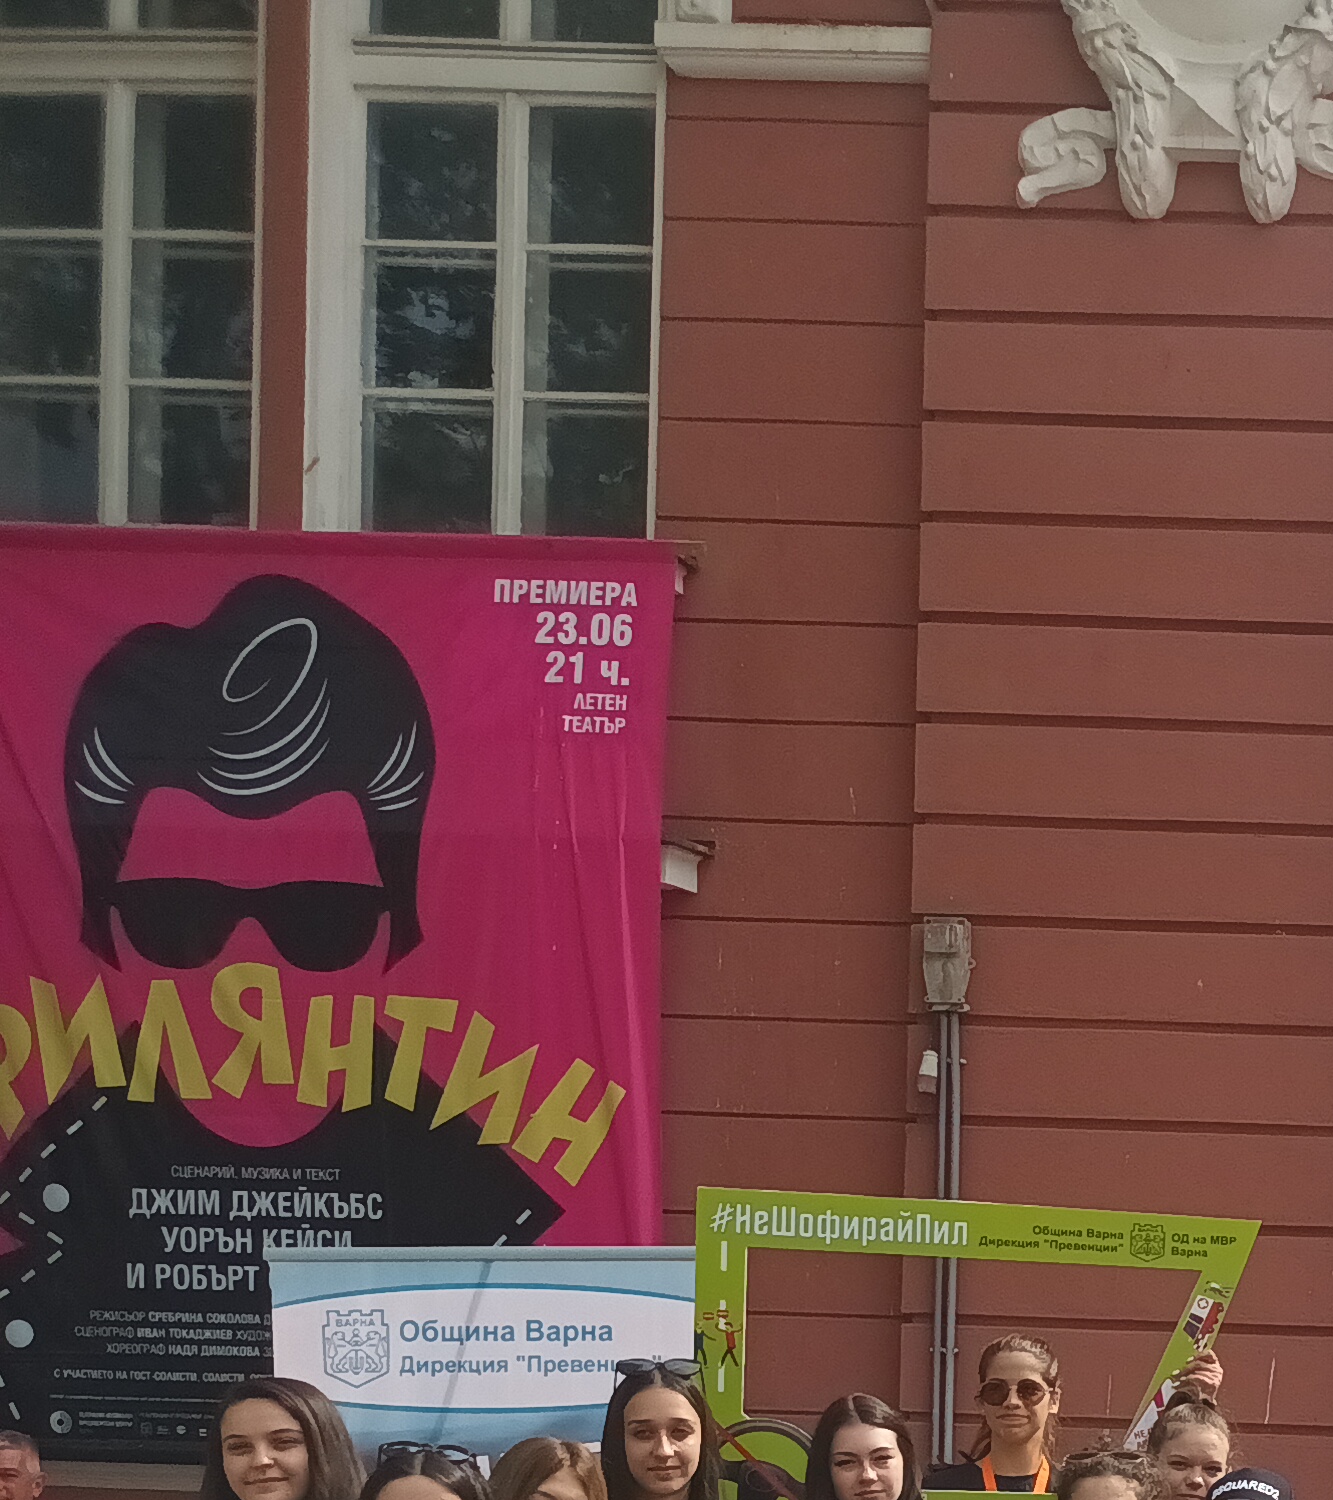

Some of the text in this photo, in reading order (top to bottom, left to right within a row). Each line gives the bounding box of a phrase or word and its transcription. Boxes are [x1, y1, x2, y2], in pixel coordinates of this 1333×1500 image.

[494, 578, 638, 607] ПРЕМИЕРА
[534, 611, 633, 647] 23.06
[544, 650, 630, 686] 21 ч.
[573, 692, 628, 711] ЛЕТЕН
[562, 714, 627, 734] ТЕАТЪР
[241, 1166, 290, 1180] МУЗИКА
[293, 1168, 302, 1180] И
[305, 1168, 342, 1181] ТЕКСТ
[129, 1186, 384, 1221] ДЖИМ ДЖЕЙКЪБС
[709, 1203, 968, 1246] #НеШофирайПил
[1032, 1225, 1124, 1240] Община Варна
[161, 1224, 352, 1254] УОРЪН КЕЙСИ
[978, 1236, 1124, 1253] Дирекция "Превенции"
[1171, 1233, 1237, 1246] ОД на МВР
[1171, 1247, 1208, 1258] Варна
[126, 1262, 260, 1292] И РОБЪРТ
[148, 1310, 204, 1323] СРЕБРИНА
[206, 1311, 261, 1325] СОКОЛОВА
[335, 1317, 376, 1328] ВАРНА
[136, 1327, 166, 1339] ИВАН
[400, 1319, 614, 1348] Община Варна
[168, 1344, 199, 1357] НАДЯ
[399, 1355, 509, 1376] Дирекция
[115, 1370, 128, 1381] НА
